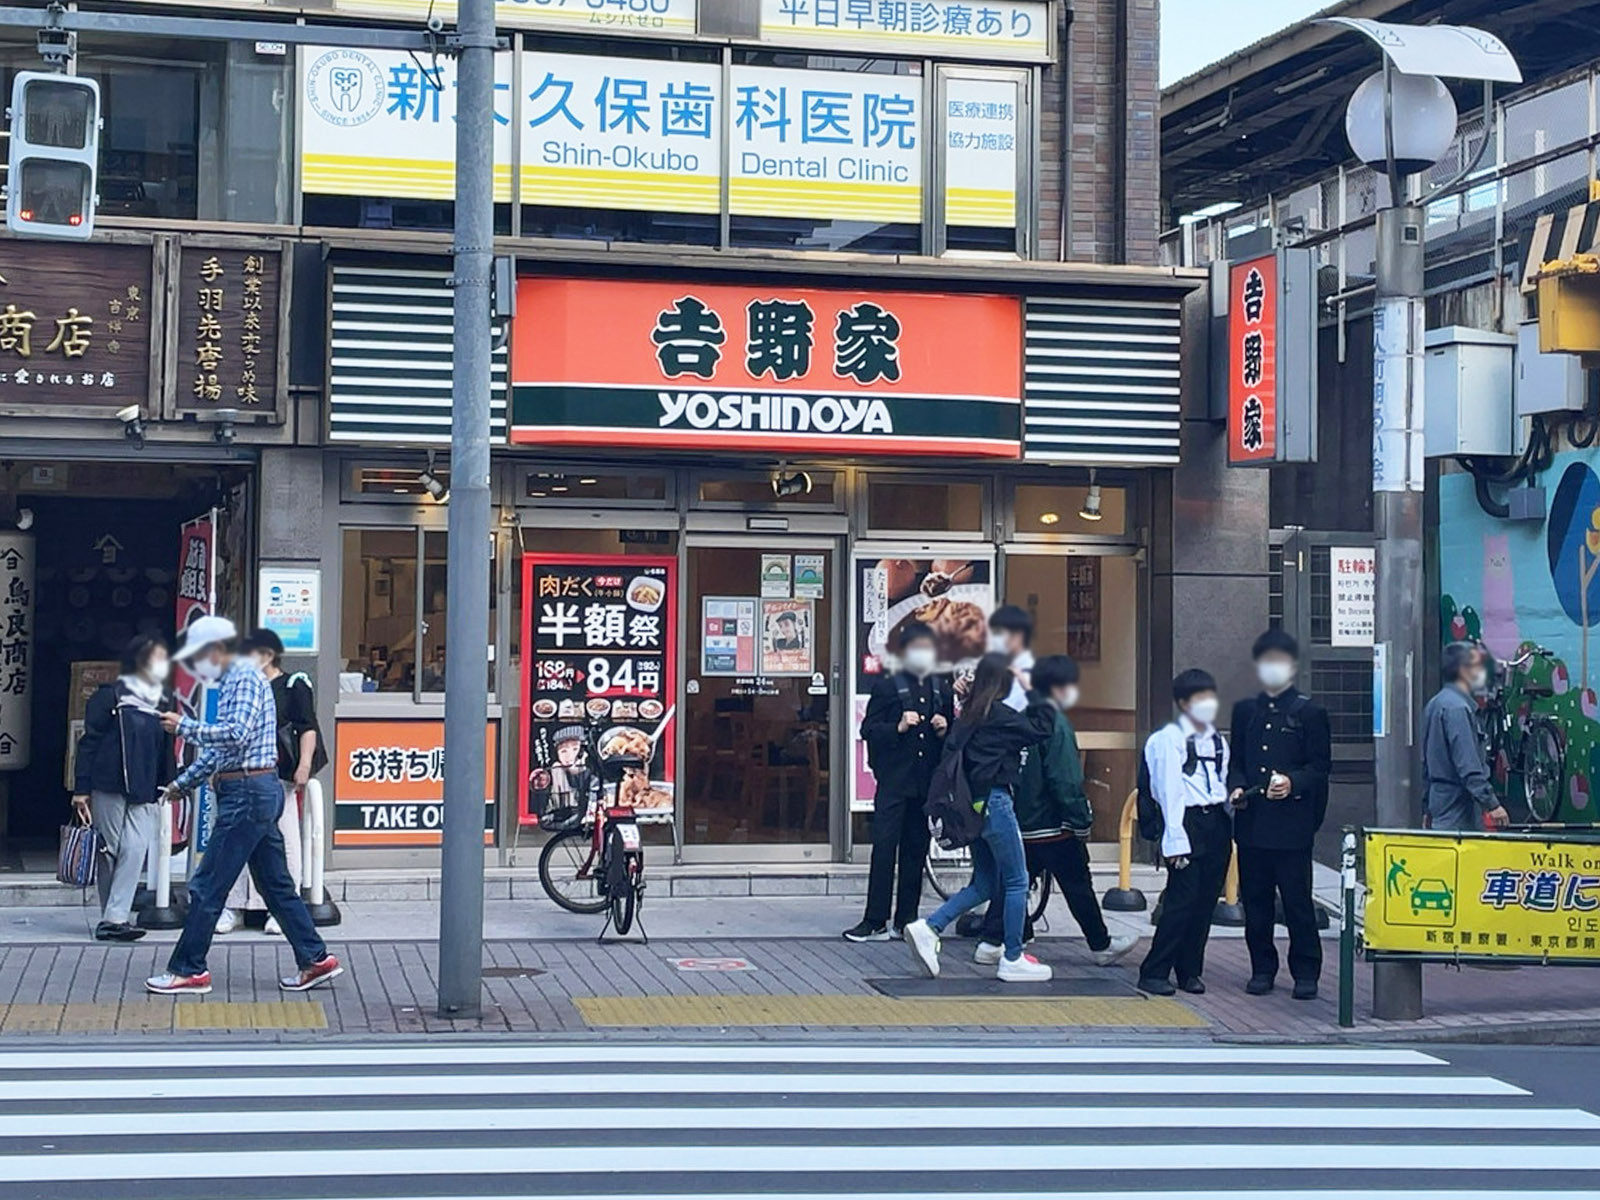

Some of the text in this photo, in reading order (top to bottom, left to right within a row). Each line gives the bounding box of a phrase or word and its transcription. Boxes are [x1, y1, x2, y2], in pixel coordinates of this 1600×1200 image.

[590, 12, 663, 28] ムシバゼロ
[779, 0, 1031, 38] 平日早朝診療あり
[948, 101, 1014, 120] 医療連携
[543, 141, 699, 171] Shin-Okubo
[948, 131, 1014, 151] 協力施設
[742, 152, 909, 182] Dental Clinic
[194, 256, 224, 400] 手羽先唐揚
[651, 295, 903, 386] 吉野家
[657, 392, 893, 434] YOSHINOYA
[539, 575, 592, 597] 肉だく
[3, 577, 31, 695] 鳥良商店
[538, 602, 660, 647] 半額祭
[586, 657, 659, 694] 84円
[361, 805, 444, 828] TAKE O
[1530, 852, 1574, 868] Walk
[1480, 867, 1600, 912] 車道に
[1567, 916, 1599, 932] 인도
